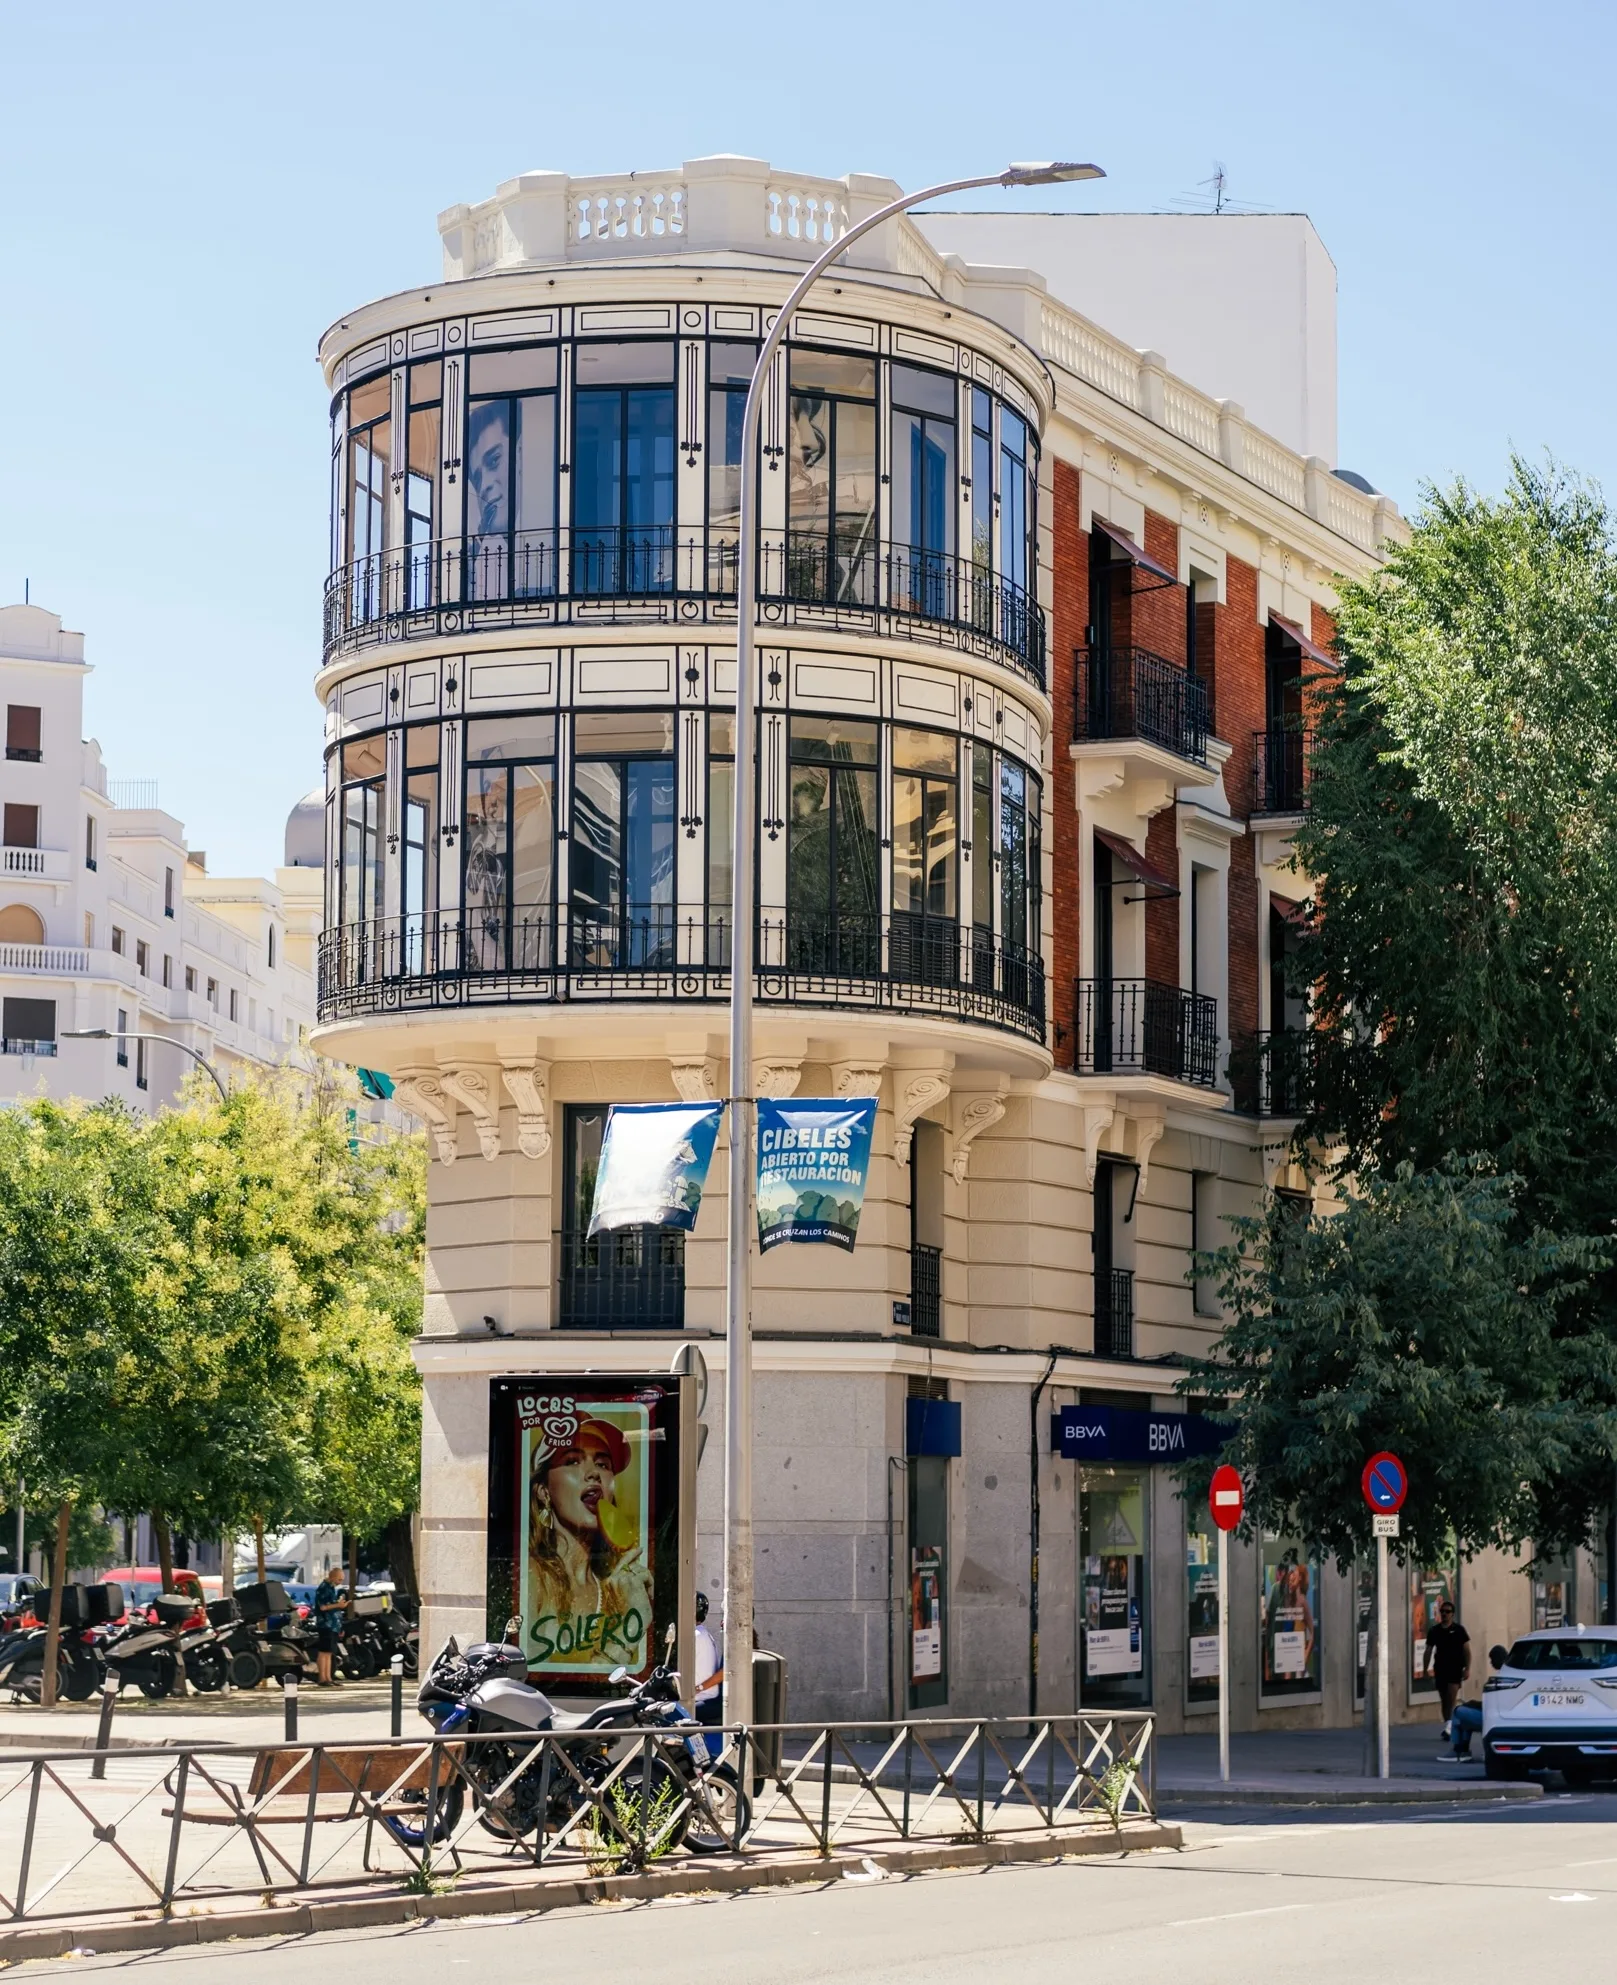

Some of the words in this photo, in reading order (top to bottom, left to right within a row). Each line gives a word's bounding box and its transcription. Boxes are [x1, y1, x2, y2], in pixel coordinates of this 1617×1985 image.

[762, 1128, 852, 1152] CIBELES
[761, 1151, 816, 1171] ABIERTO
[820, 1151, 849, 1166] POR
[809, 1228, 822, 1236] LOS
[823, 1228, 850, 1244] CAMINOS
[517, 1396, 576, 1418] LOCOS
[522, 1417, 541, 1428] POR
[1065, 1425, 1106, 1439] BBVA
[548, 1438, 572, 1447] FRIGO
[1148, 1422, 1185, 1451] BBVA
[526, 1608, 644, 1666] SOLERO
